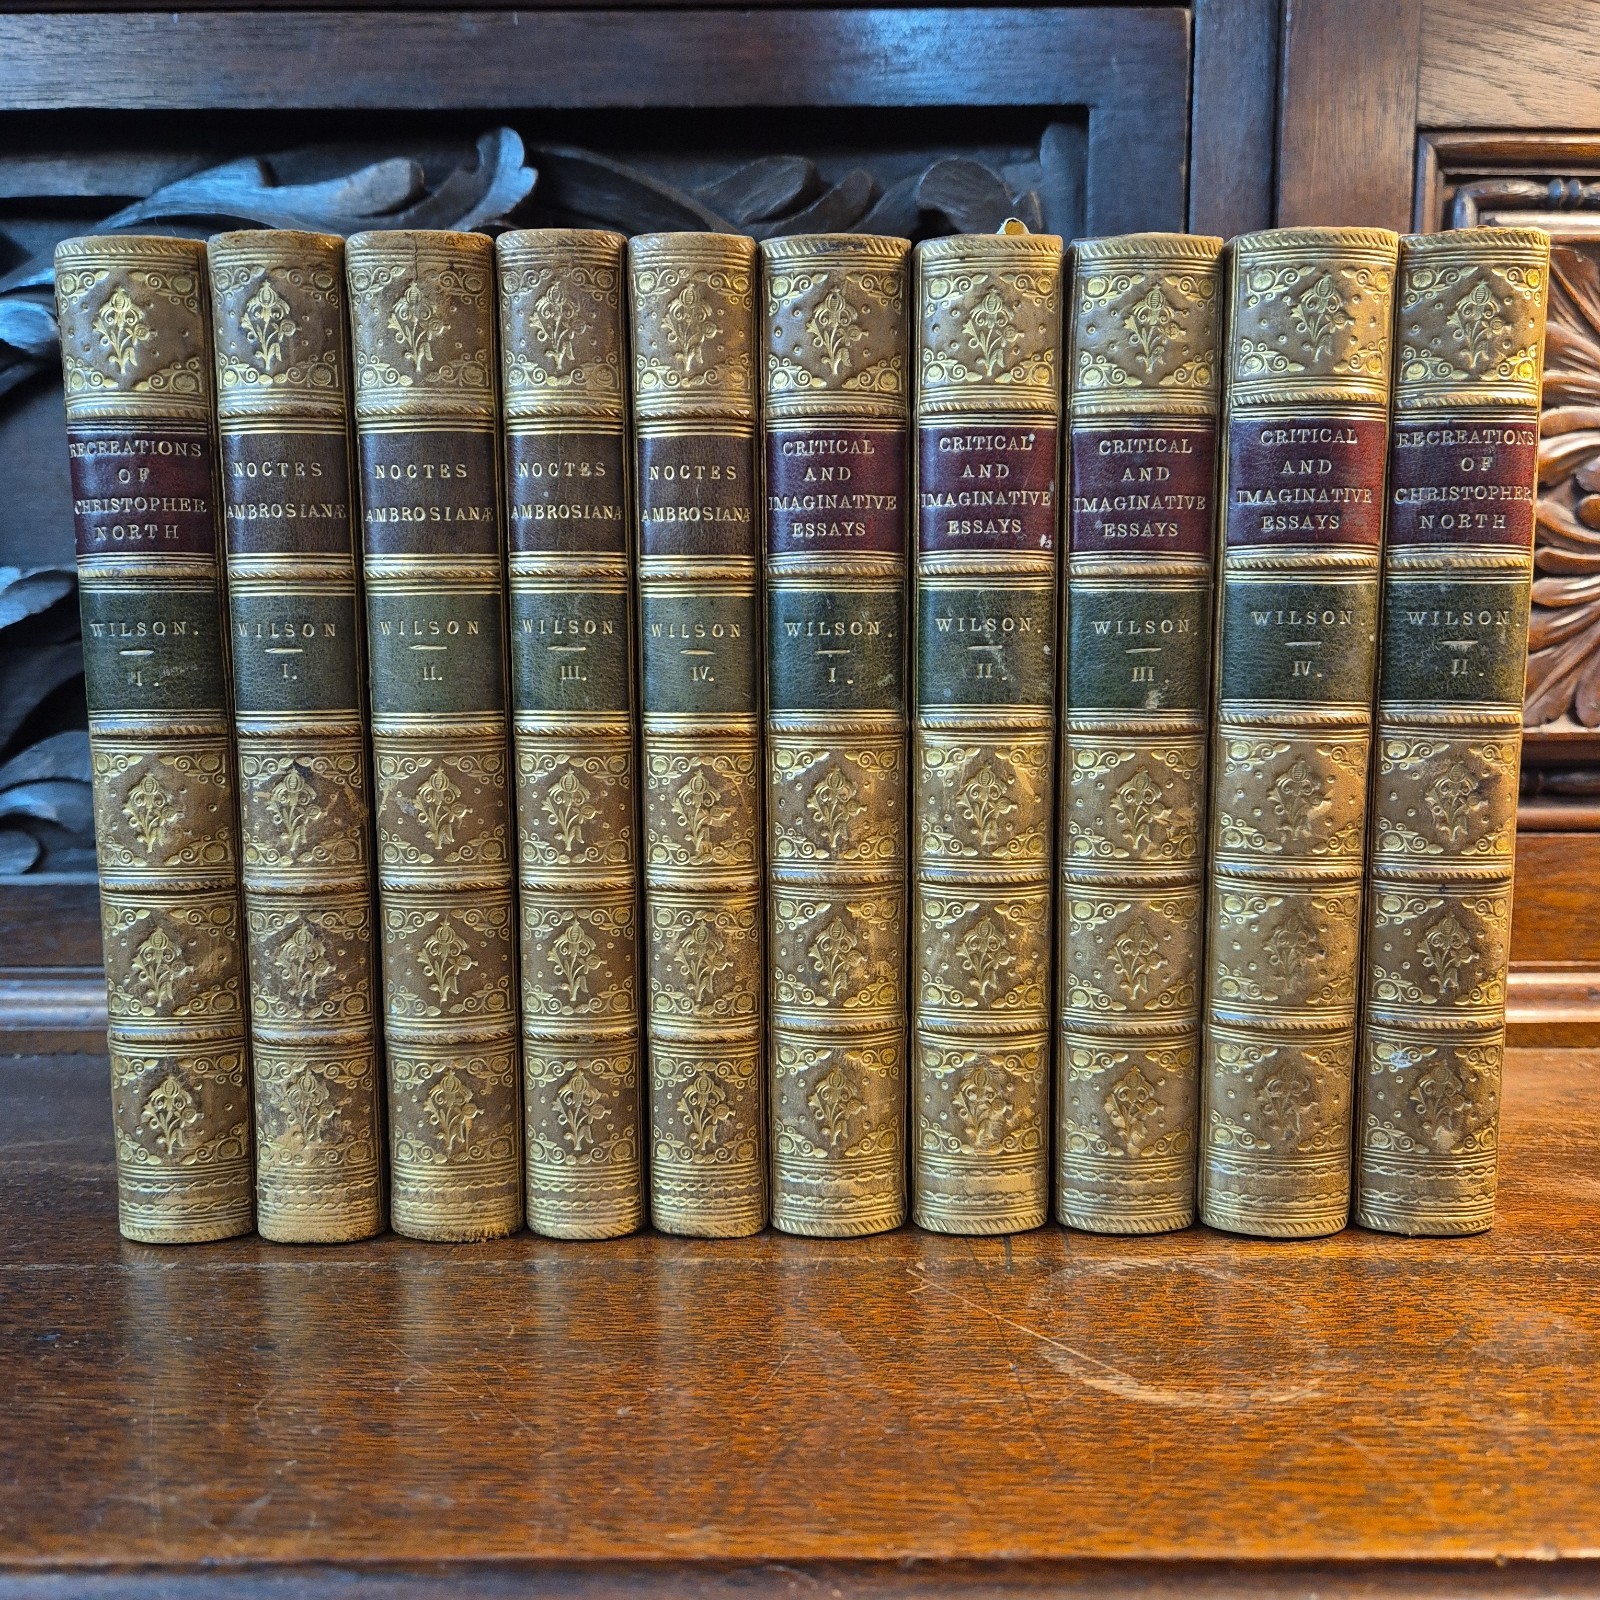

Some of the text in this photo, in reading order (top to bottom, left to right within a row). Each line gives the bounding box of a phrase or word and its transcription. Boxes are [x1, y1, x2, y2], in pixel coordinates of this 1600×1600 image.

[940, 435, 1033, 452] CRITICAL
[1260, 428, 1358, 444] CRITICAL
[1396, 429, 1534, 448] RECREATIONS
[69, 440, 202, 458] RECREATIONS
[783, 440, 875, 456] CRITICAL
[1099, 439, 1193, 455] CRITICAL
[234, 462, 322, 477] NOCTES
[375, 464, 467, 479] NOCTES
[519, 462, 606, 477] NOCTES
[961, 464, 1010, 478] AND
[1280, 460, 1332, 474] AND
[1460, 457, 1492, 471] OF
[118, 467, 150, 483] OF
[649, 465, 737, 480] NOCTES
[803, 467, 851, 481] AND
[1121, 467, 1170, 481] AND
[921, 491, 1051, 507] IMAGINATIVE
[1237, 488, 1372, 505] IMAGINATIVE
[1394, 486, 1532, 504] CHRISTOPHER
[75, 497, 207, 515] CHRISTOPHER
[769, 495, 897, 511] IMAGINATIVE
[1073, 496, 1205, 512] IMAGINATIVE
[947, 519, 1022, 534] ESSAYS
[1261, 515, 1340, 532] ESSAYS
[1420, 515, 1506, 529] NORTH
[95, 524, 179, 541] NORTH
[792, 522, 866, 538] ESSAYS
[1103, 523, 1178, 537] ESSAYS
[239, 623, 336, 638] WILSON
[380, 620, 479, 635] WILSON
[523, 620, 613, 634] WILSON
[651, 623, 741, 638] WILSON
